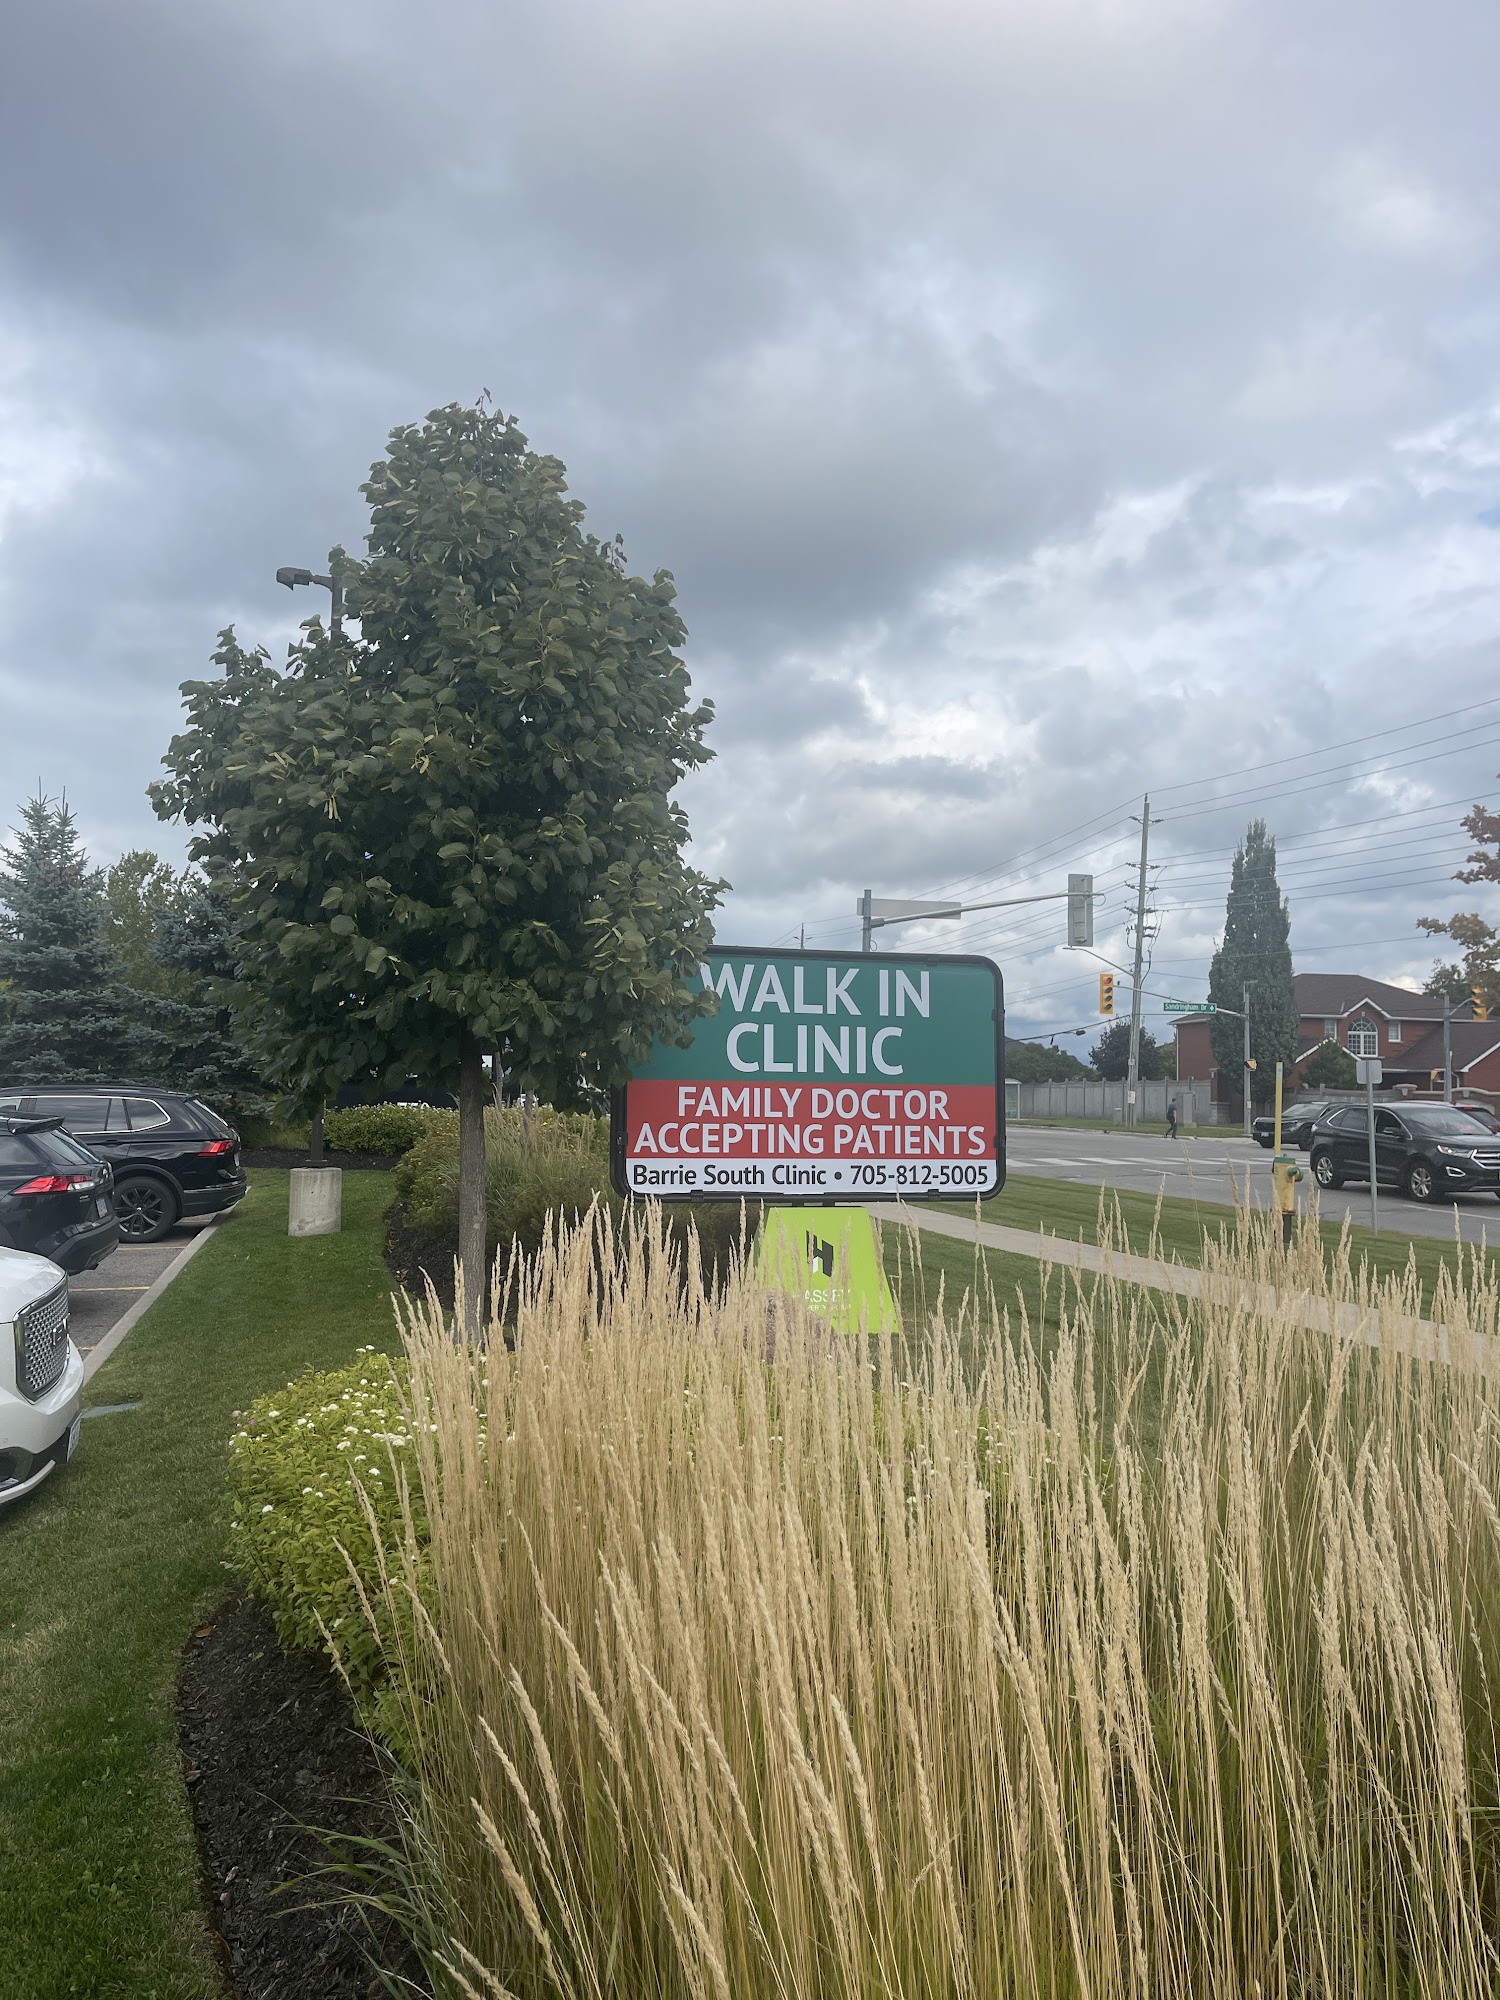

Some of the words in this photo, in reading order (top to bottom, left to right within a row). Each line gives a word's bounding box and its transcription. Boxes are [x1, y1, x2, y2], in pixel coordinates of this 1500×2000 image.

[700, 962, 862, 1016] WALK
[878, 969, 930, 1018] IN
[1165, 1003, 1199, 1011] Sandringham
[726, 1022, 904, 1076] CLINIC
[678, 1086, 802, 1119] FAMILY
[811, 1087, 950, 1121] DOCTOR
[633, 1122, 825, 1155] ACCEPTING
[834, 1124, 986, 1156] PATIENTS
[633, 1164, 697, 1186] Barrie
[703, 1164, 765, 1186] South
[771, 1164, 827, 1186] Clinic
[850, 1164, 988, 1186] 705-812-5005
